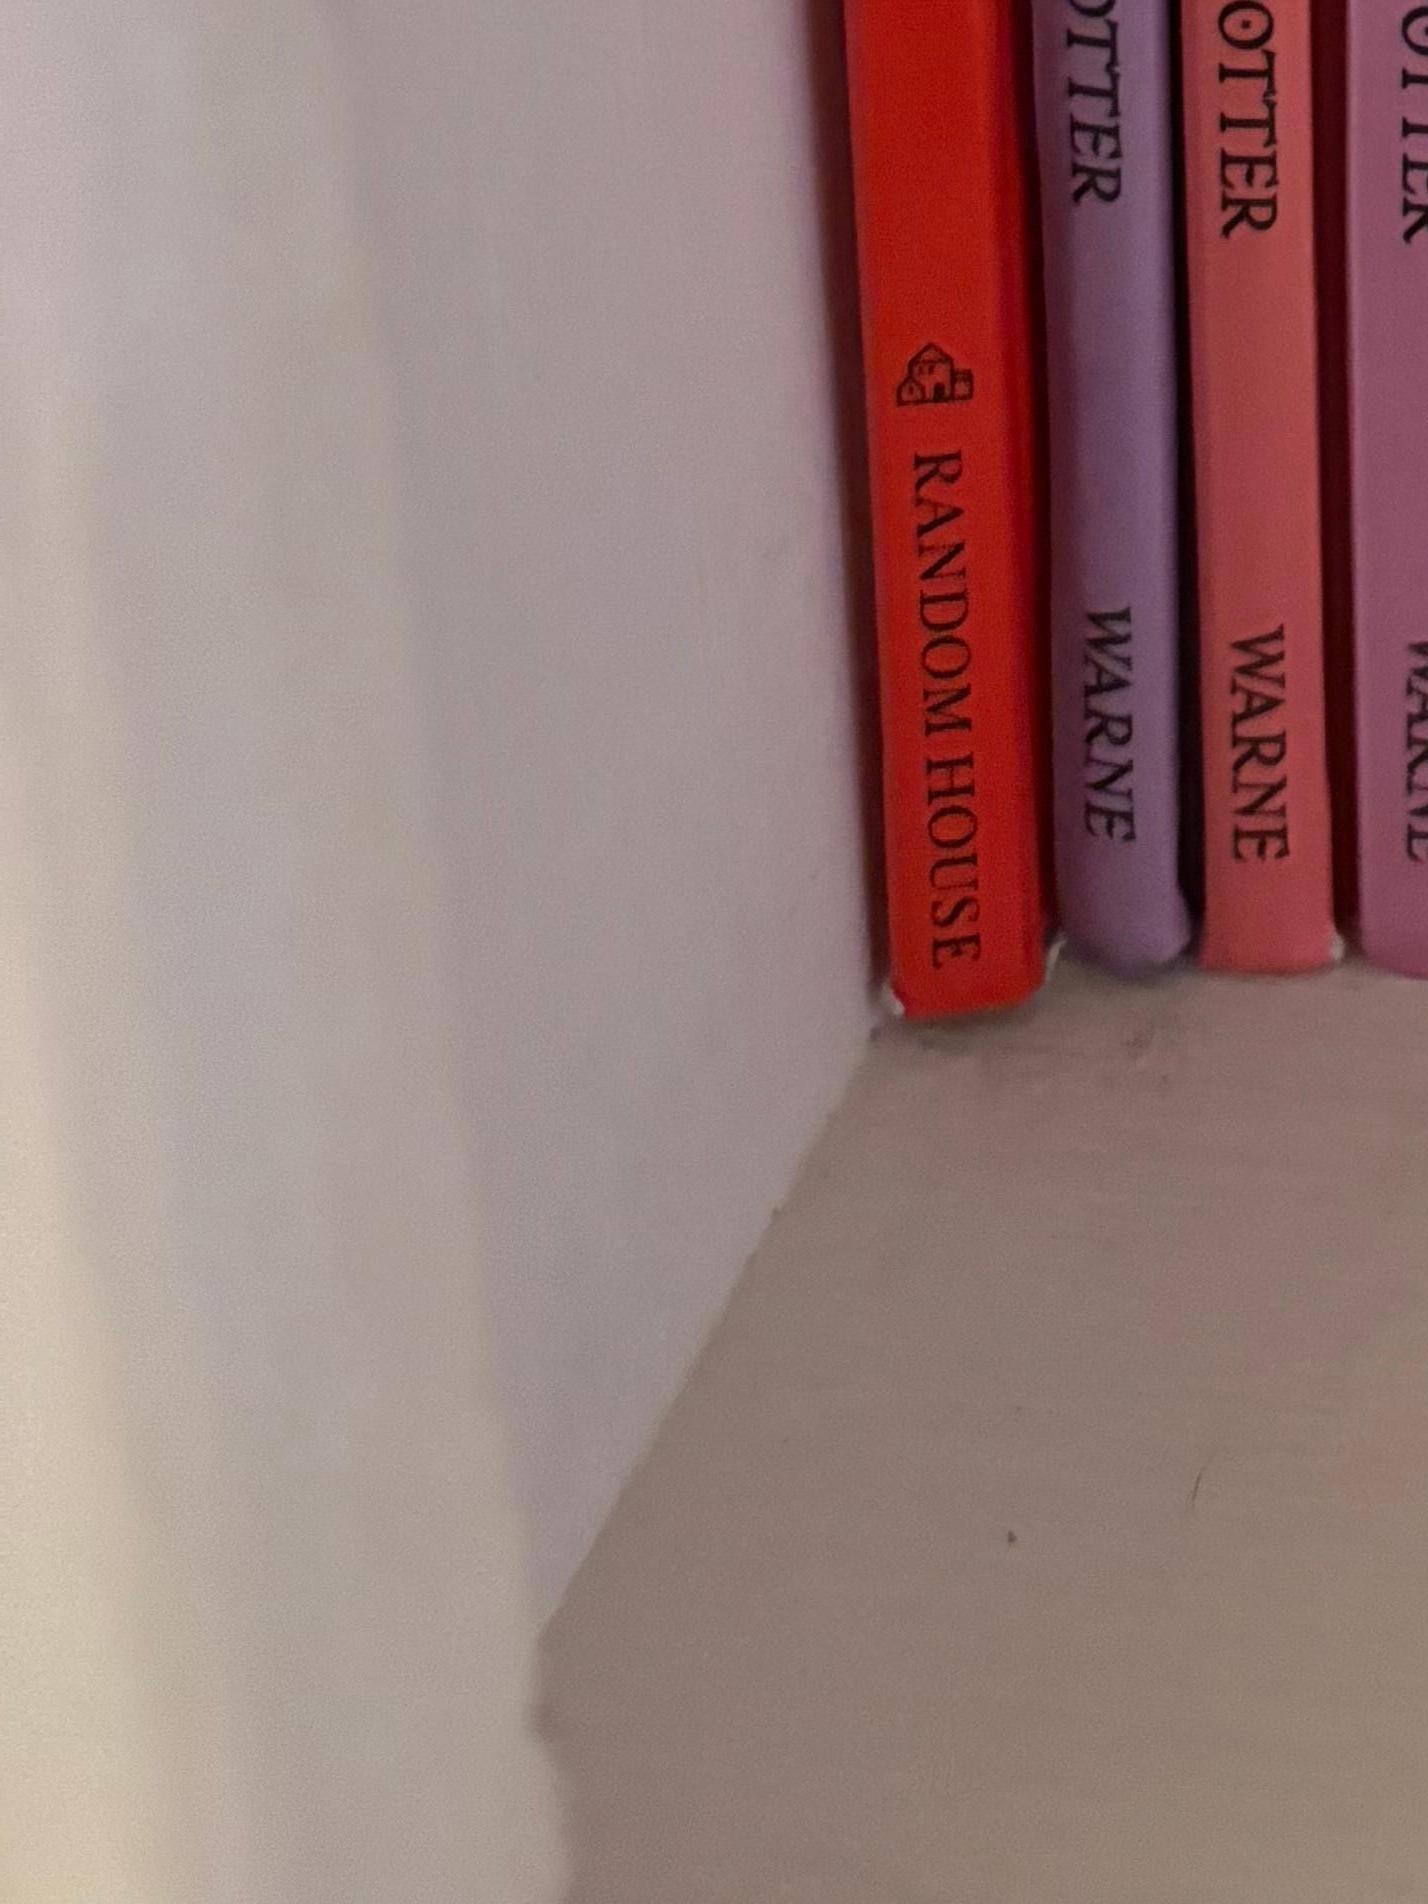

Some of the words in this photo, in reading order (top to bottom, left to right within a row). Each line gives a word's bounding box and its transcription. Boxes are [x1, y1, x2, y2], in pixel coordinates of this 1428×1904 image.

[913, 448, 974, 738] RANDOM
[1084, 606, 1136, 842] WARNE
[1230, 624, 1290, 861] WARNE
[926, 750, 983, 970] HOUSE
